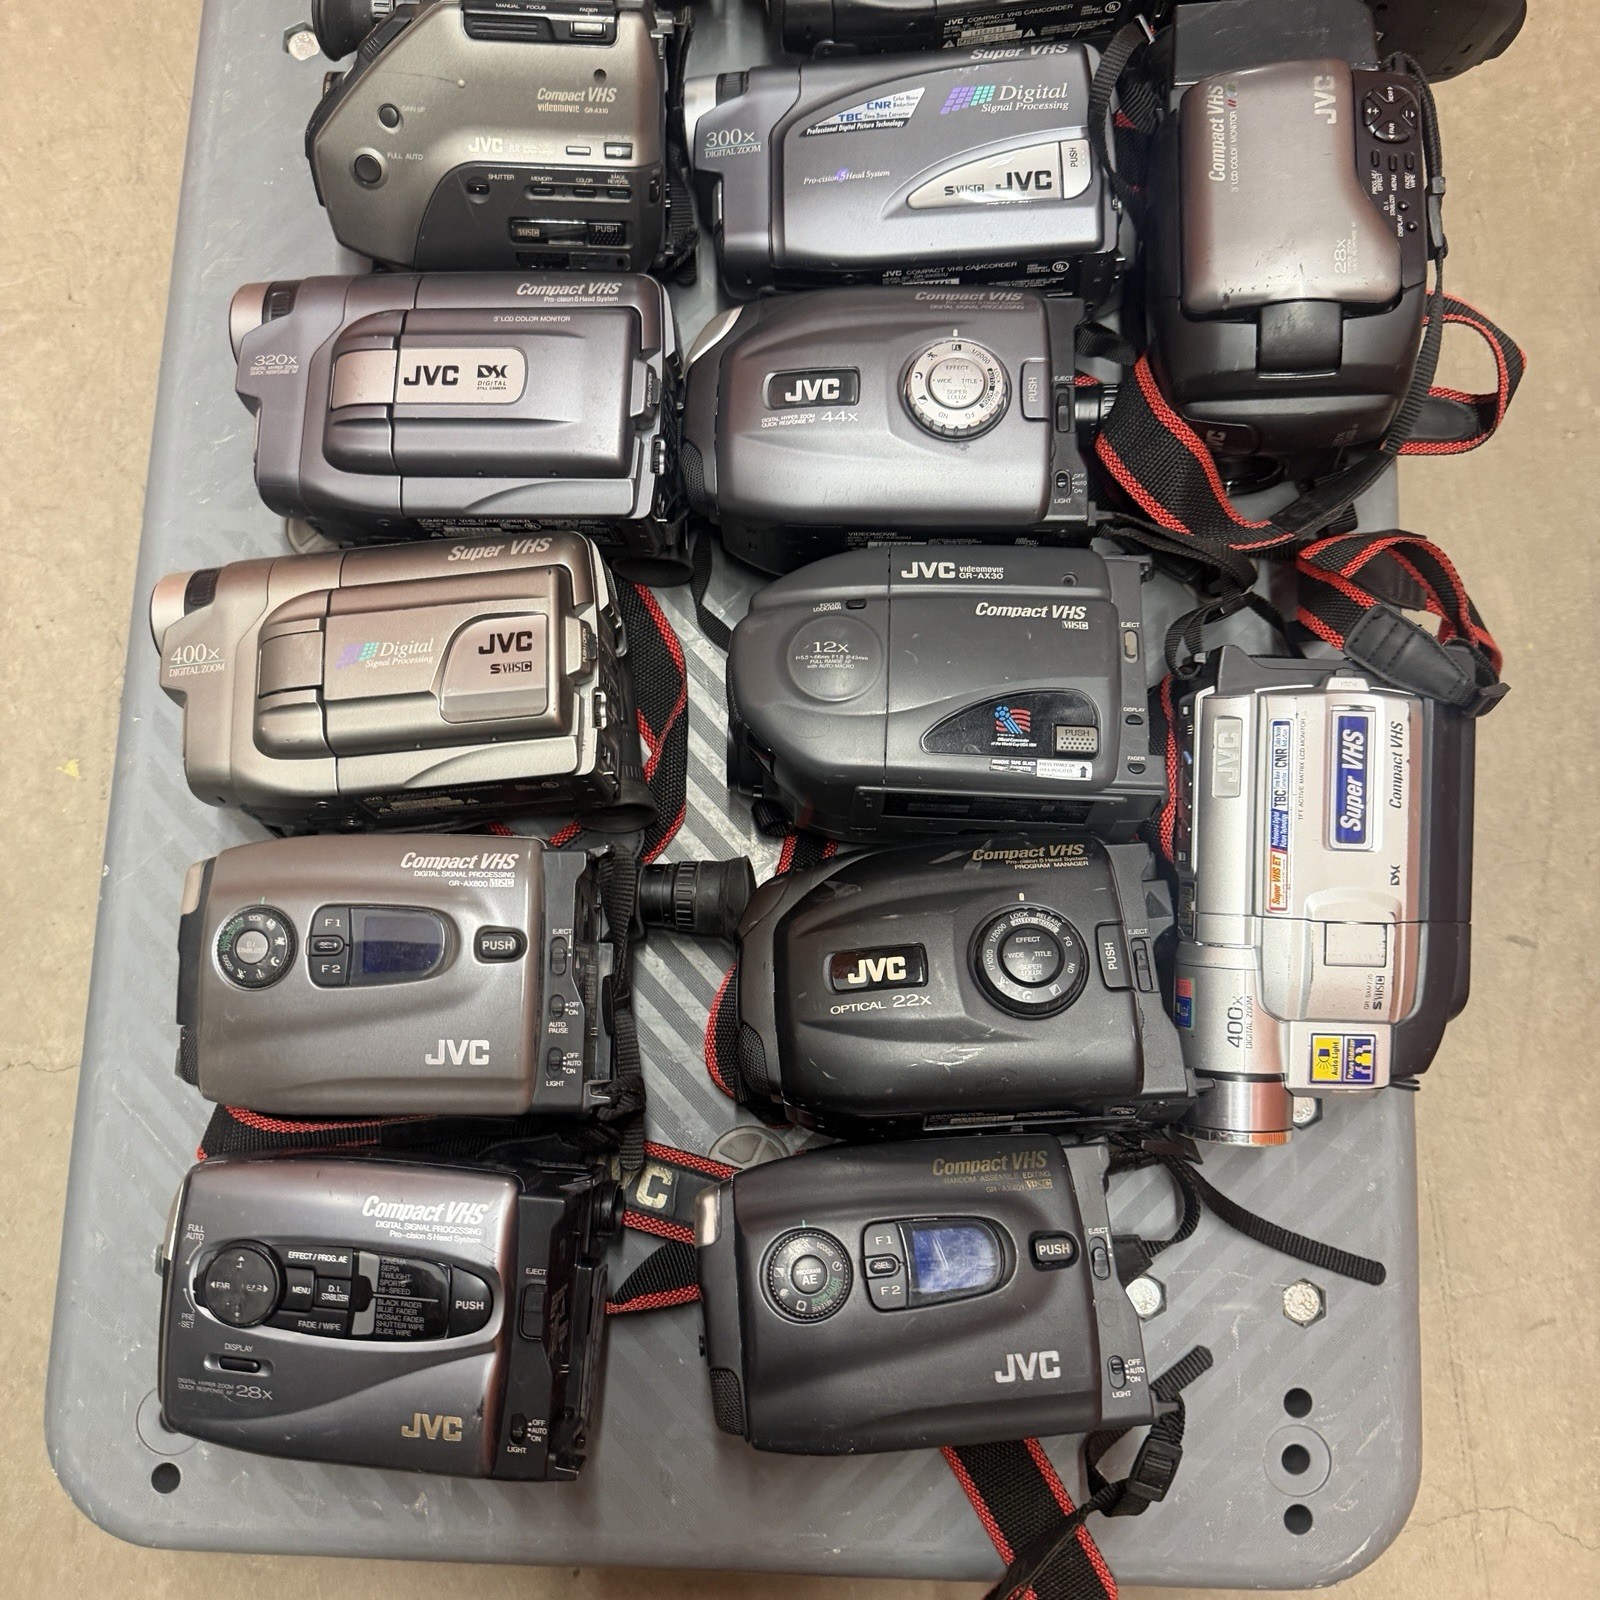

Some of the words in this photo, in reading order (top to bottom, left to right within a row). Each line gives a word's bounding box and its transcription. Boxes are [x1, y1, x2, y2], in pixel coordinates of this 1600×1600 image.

[944, 18, 964, 26] JVC
[968, 13, 1004, 23] COMPACT
[1024, 4, 1074, 16] CAMCORDER
[970, 48, 1024, 60] Super
[1030, 44, 1070, 56] VHS
[537, 88, 584, 102] Compact
[588, 87, 618, 102] VHS
[999, 82, 1068, 103] Digital
[1206, 85, 1224, 115] VHS
[1314, 76, 1337, 124] JVC
[866, 101, 892, 110] CNR
[982, 103, 1012, 114] Signal
[1015, 101, 1069, 111] Processing
[838, 113, 862, 122] TBC
[468, 137, 502, 153] JVC
[705, 148, 736, 158] DIGITAL
[738, 144, 761, 154] ZOOM
[1208, 118, 1226, 182] Compact
[1069, 148, 1078, 168] PUSH
[996, 170, 1052, 191] JVC
[516, 283, 586, 296] Compact
[589, 282, 622, 295] VHS
[914, 292, 986, 301] Compact
[989, 292, 1024, 300] VHS
[254, 354, 298, 366] 320x
[404, 365, 459, 386] JVC
[785, 378, 840, 402] JVC
[1028, 377, 1037, 402] PUSH
[822, 411, 858, 422] 44x
[448, 544, 504, 561] Super
[510, 537, 553, 555] VHS
[901, 562, 956, 578] JVC
[975, 602, 1048, 618] Compact
[1052, 605, 1087, 620] VHS
[380, 638, 434, 657] Digital
[478, 631, 533, 654] JVC
[813, 641, 849, 653] 12x
[366, 658, 391, 669] Signal
[392, 654, 434, 666] Processing
[170, 666, 200, 677] DIGITAL
[1390, 722, 1404, 750] VHS
[1341, 729, 1364, 770] VHS
[1218, 732, 1240, 784] JVC
[1275, 748, 1288, 768] CNR
[1389, 751, 1403, 810] Compact
[1274, 790, 1286, 808] TBC
[1340, 776, 1365, 832] Super
[972, 846, 1046, 861] Compact
[1049, 844, 1085, 857] VHS
[400, 852, 478, 870] Compact
[480, 853, 520, 870] VHS
[1272, 885, 1282, 904] Super
[325, 918, 341, 926] F1
[1010, 911, 1028, 920] LOCK
[990, 923, 1006, 942] 1/2000
[482, 941, 514, 950] PUSH
[1062, 935, 1073, 947] FG
[986, 949, 996, 970] 1/1000
[1104, 942, 1118, 970] PUSH
[322, 964, 341, 974] F2
[848, 956, 906, 984] JVC
[1067, 962, 1076, 974] ND
[830, 1002, 886, 1014] OPTICAL
[892, 994, 932, 1008] 22x
[1227, 996, 1243, 1048] 400x
[425, 1040, 490, 1066] JVC
[1332, 1042, 1340, 1059] Light
[932, 1155, 1008, 1176] Compact
[1011, 1150, 1048, 1170] VHS
[362, 1196, 446, 1222] Compact
[446, 1201, 490, 1225] VHS
[186, 1232, 204, 1240] AUTO
[188, 1224, 204, 1232] FULL
[376, 1220, 403, 1230] DIGITAL
[404, 1222, 432, 1232] SIGNAL
[432, 1225, 482, 1236] PROCESSING
[1088, 1226, 1108, 1235] EJECT
[875, 1236, 892, 1245] F1
[288, 1251, 313, 1260] EFFECT
[1038, 1244, 1071, 1256] PUSH
[216, 1282, 230, 1290] FAR
[802, 1274, 818, 1286] AE
[292, 1286, 311, 1294] MENU
[880, 1286, 901, 1296] F2
[456, 1300, 484, 1310] PUSH
[298, 1320, 317, 1329] FADE
[323, 1322, 342, 1331] WIPE
[402, 1316, 424, 1324] FADER
[224, 1343, 254, 1352] DISPLAY
[994, 1350, 1061, 1384] JVC
[236, 1385, 274, 1400] 28x
[1112, 1390, 1132, 1398] LIGHT
[402, 1413, 462, 1442] JVC
[507, 1446, 527, 1454] LIGHT
